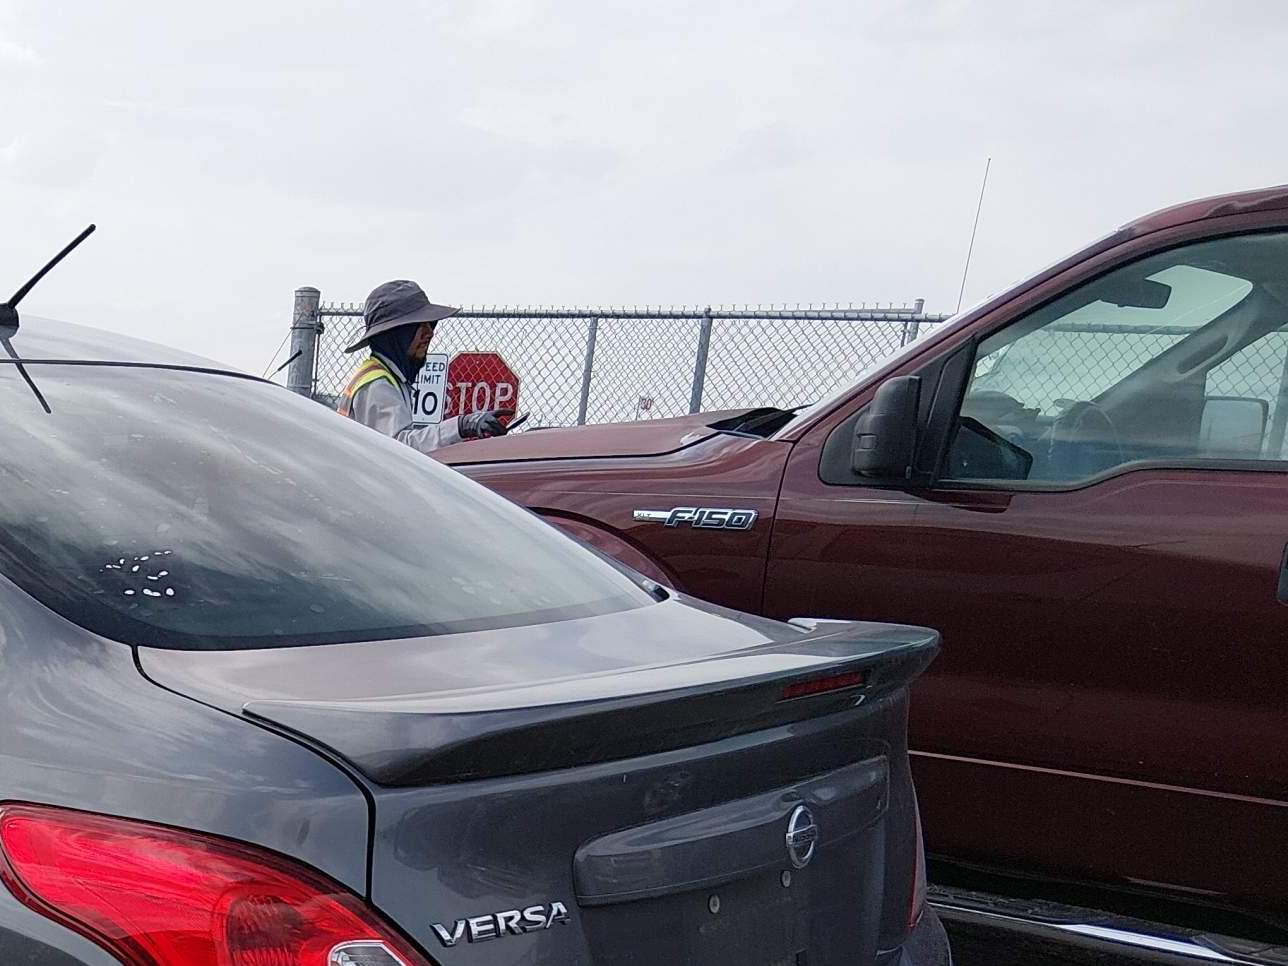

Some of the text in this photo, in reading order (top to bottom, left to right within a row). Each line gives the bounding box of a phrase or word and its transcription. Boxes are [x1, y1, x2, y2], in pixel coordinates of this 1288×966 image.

[424, 361, 446, 372] EED
[413, 389, 438, 415] 10
[664, 506, 759, 530] F-150
[430, 901, 571, 947] VERSA
